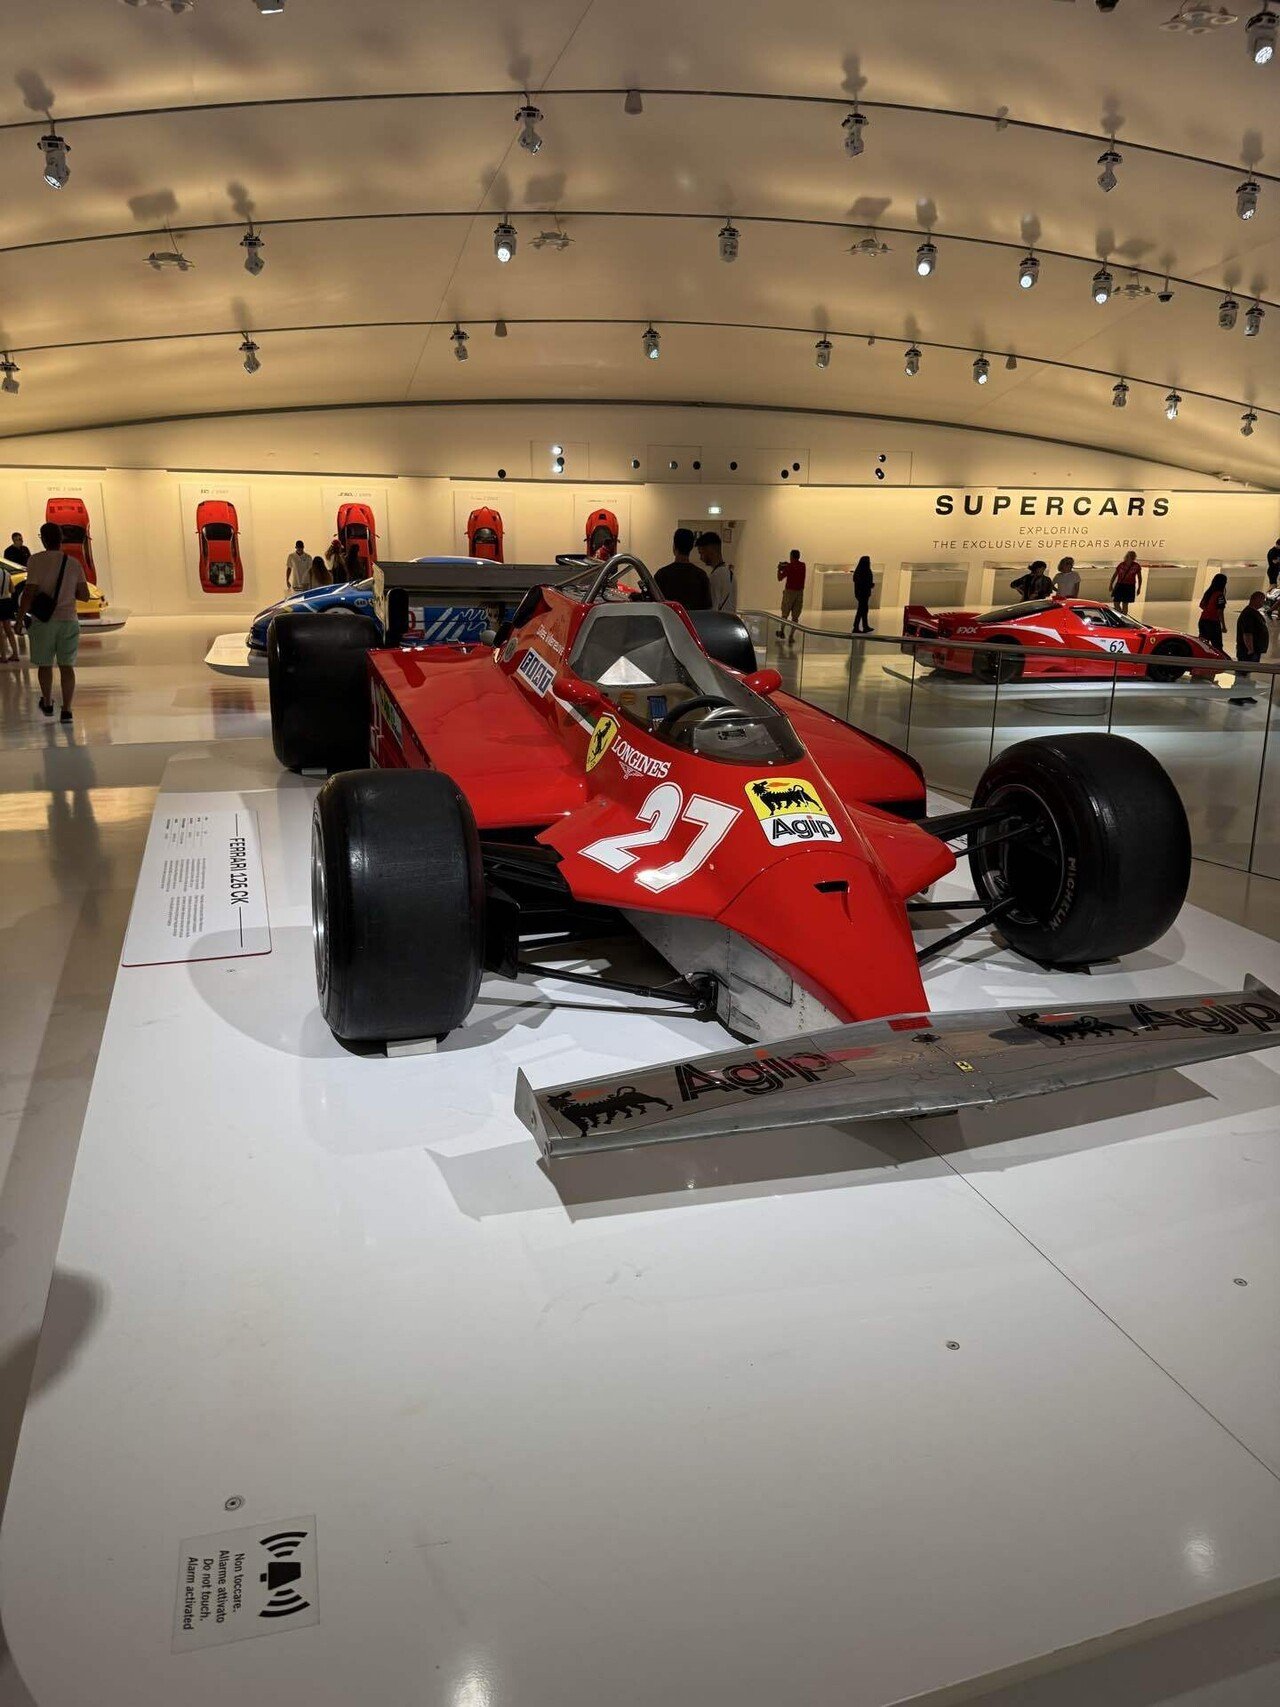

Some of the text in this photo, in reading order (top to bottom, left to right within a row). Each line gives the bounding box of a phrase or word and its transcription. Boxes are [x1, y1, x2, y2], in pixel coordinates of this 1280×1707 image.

[935, 494, 1170, 517] SUPERCARS
[932, 539, 1166, 549] THE EXCLUSIVE SUPERCARS ARCHIVE
[1018, 525, 1089, 536] EXPLORING
[955, 625, 979, 635] FXX
[1109, 640, 1125, 654] 62
[518, 649, 556, 695] FIAT
[611, 735, 672, 779] LONGINES
[577, 781, 744, 894] 27
[771, 814, 836, 841] Agip
[229, 837, 249, 905] FERRARI 126 CK
[1129, 997, 1280, 1034] Agip
[674, 1049, 839, 1102] Agip
[183, 1557, 199, 1630] Alarm activated
[200, 1558, 214, 1622] Do not touch.
[216, 1550, 230, 1624] Allarme attivato
[233, 1553, 246, 1613] Non toccare.
